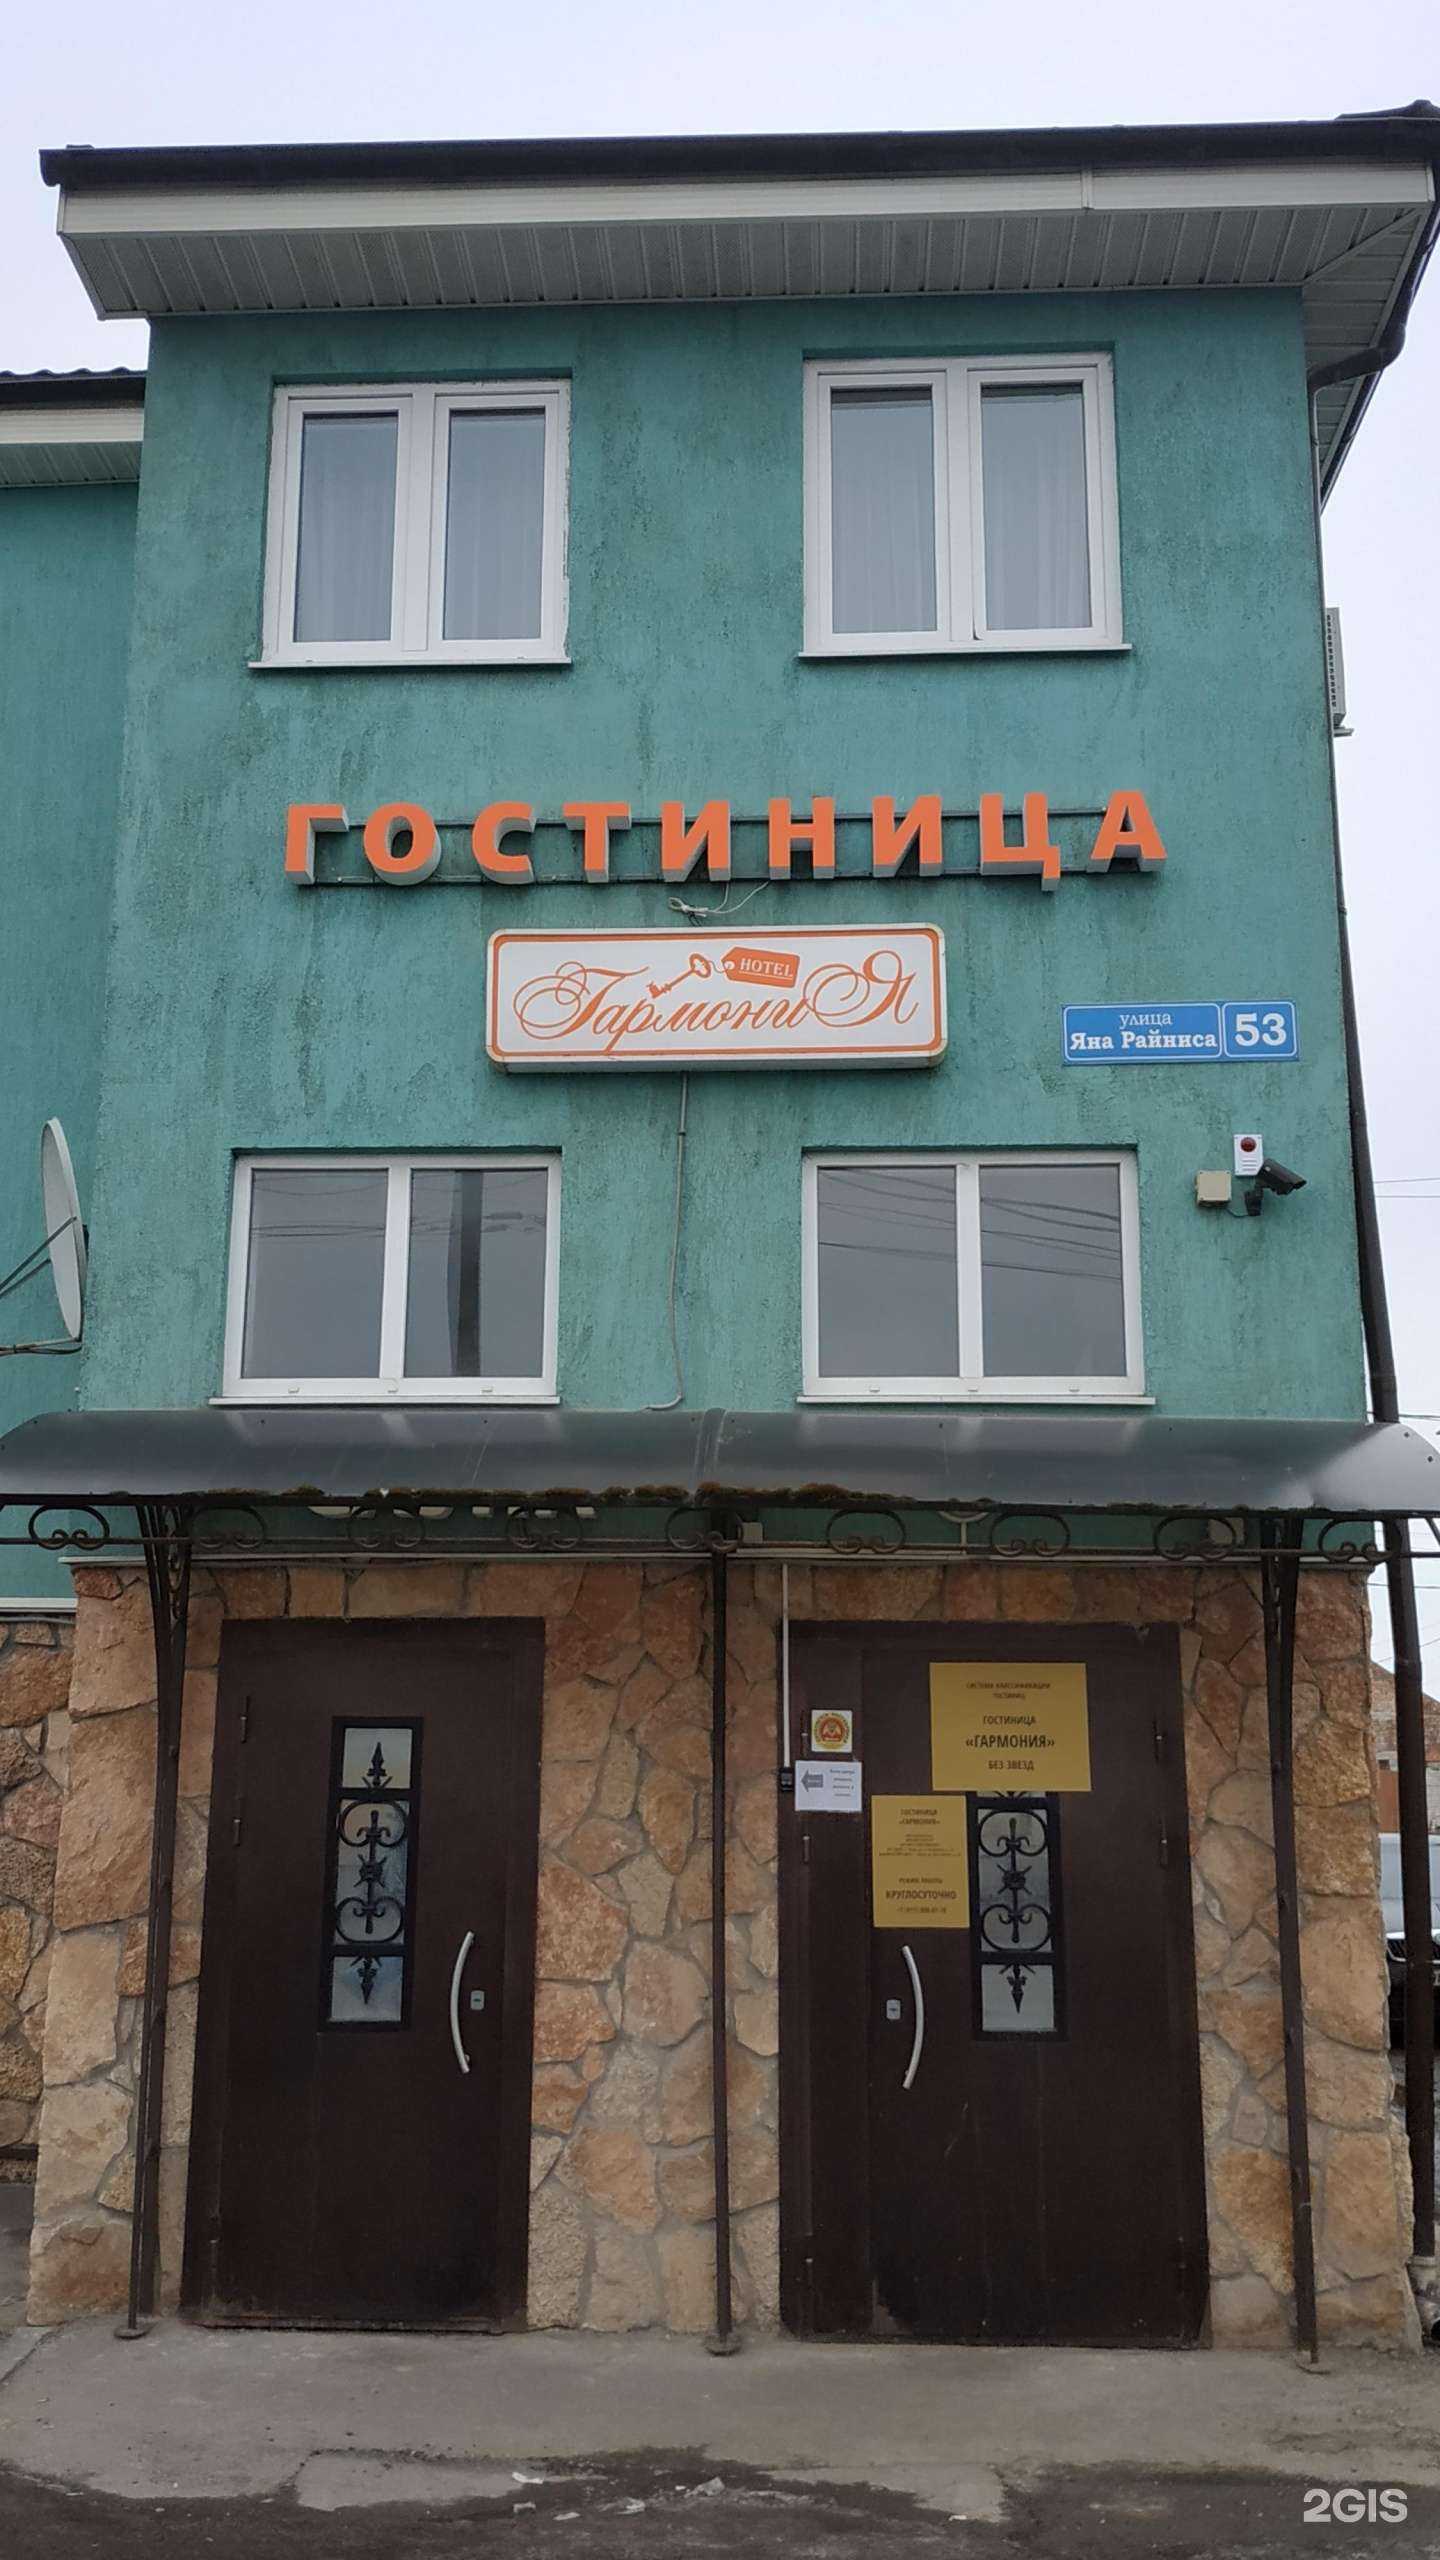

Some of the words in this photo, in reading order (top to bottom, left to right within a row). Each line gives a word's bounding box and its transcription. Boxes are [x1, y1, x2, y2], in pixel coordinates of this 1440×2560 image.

[285, 791, 1168, 891] ГОСТИНИЦА
[738, 956, 794, 979] HOTEL
[1119, 1012, 1173, 1030] улица
[1234, 1012, 1288, 1047] 53
[1069, 1031, 1114, 1050] Яна
[1120, 1028, 1218, 1050] Райниса
[983, 1715, 1036, 1726] ГОСТИНИЦА
[965, 1733, 1055, 1749] «ГАРМОНИЯ»
[987, 1759, 1004, 1771] БЕЗ
[1006, 1759, 1035, 1772] ЗВЕЗД
[885, 1889, 958, 1901] КРУГЛОСУТОЧНО
